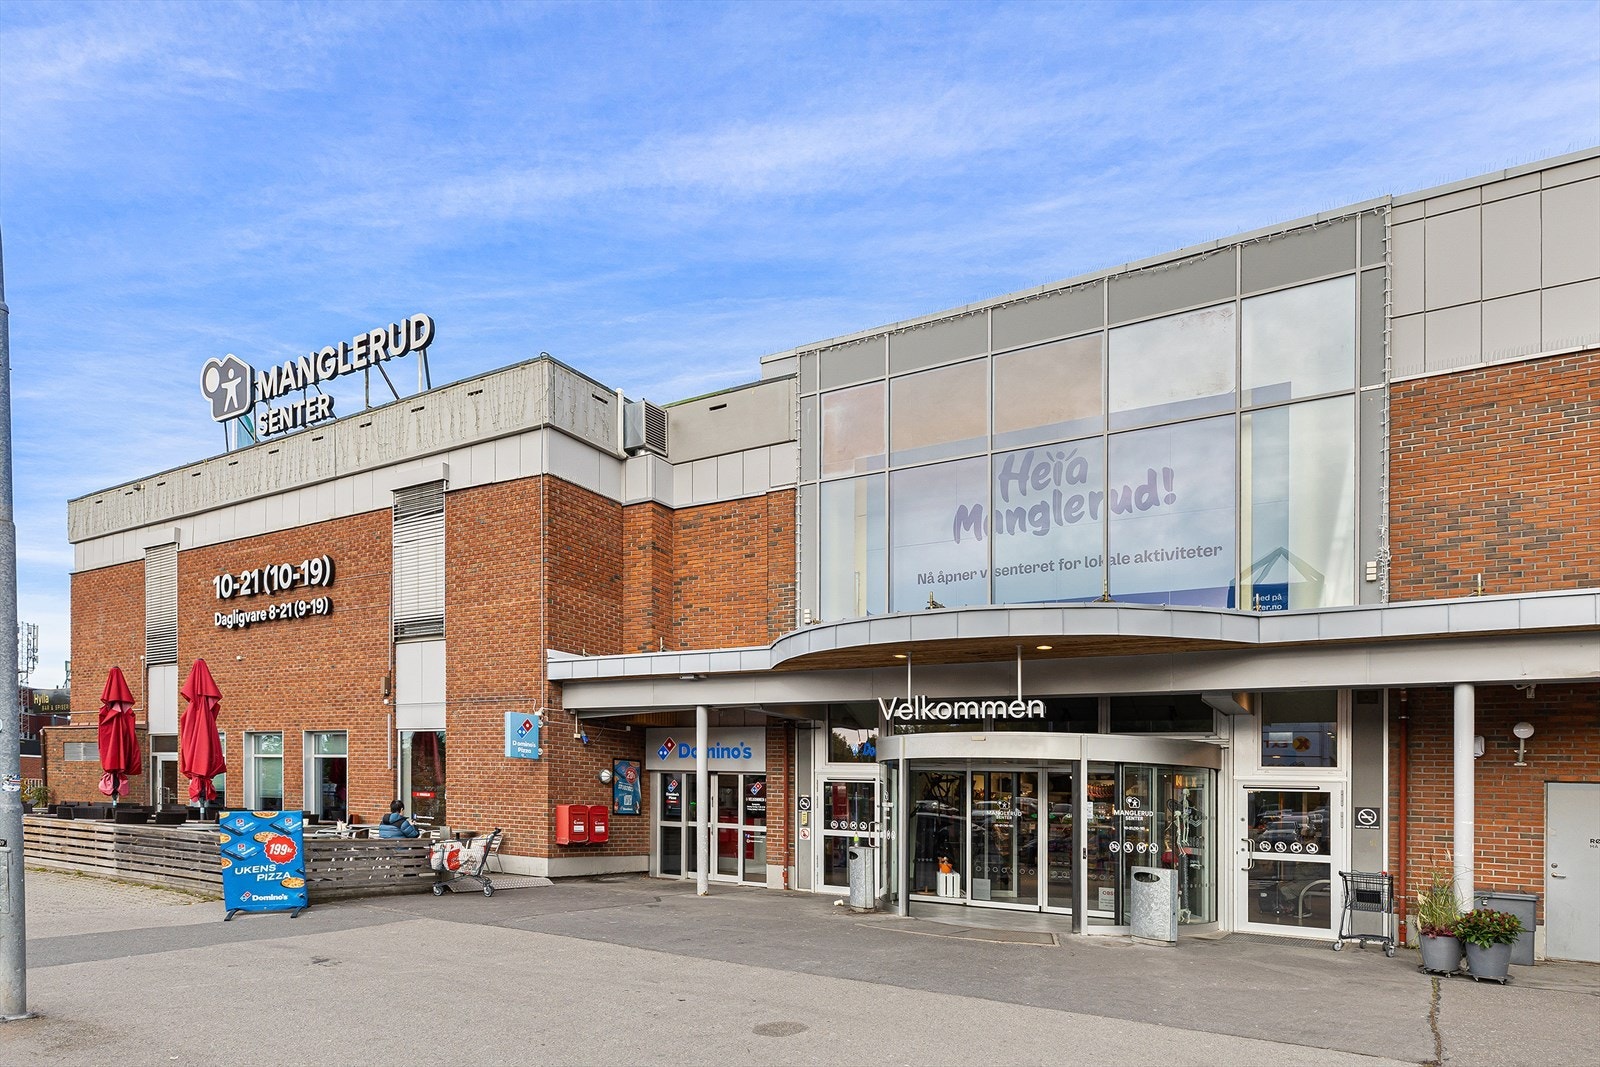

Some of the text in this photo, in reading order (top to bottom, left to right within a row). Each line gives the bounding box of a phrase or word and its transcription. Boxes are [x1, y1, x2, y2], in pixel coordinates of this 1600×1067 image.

[257, 312, 434, 401] MANGLERUD
[257, 393, 333, 436] SENTER
[998, 448, 1089, 503] Heia
[953, 467, 1177, 544] Manglerud!
[213, 554, 333, 599] 10-21 (10-19)
[917, 571, 935, 585] Nå
[937, 570, 978, 585] åpner
[994, 560, 1055, 577] senteret
[1058, 558, 1082, 571] for
[1134, 544, 1223, 564] aktiviteter
[1271, 593, 1283, 602] på
[214, 595, 331, 629] Dagligvare 8-21 (9-19)
[33, 693, 50, 706] Hylla
[878, 695, 1046, 720] Velkommen
[512, 740, 537, 748] Domino's
[1113, 809, 1154, 817] MANGLERUD
[235, 864, 277, 875] UKENS
[256, 871, 291, 882] PIZZA
[252, 893, 289, 901] Domino's
